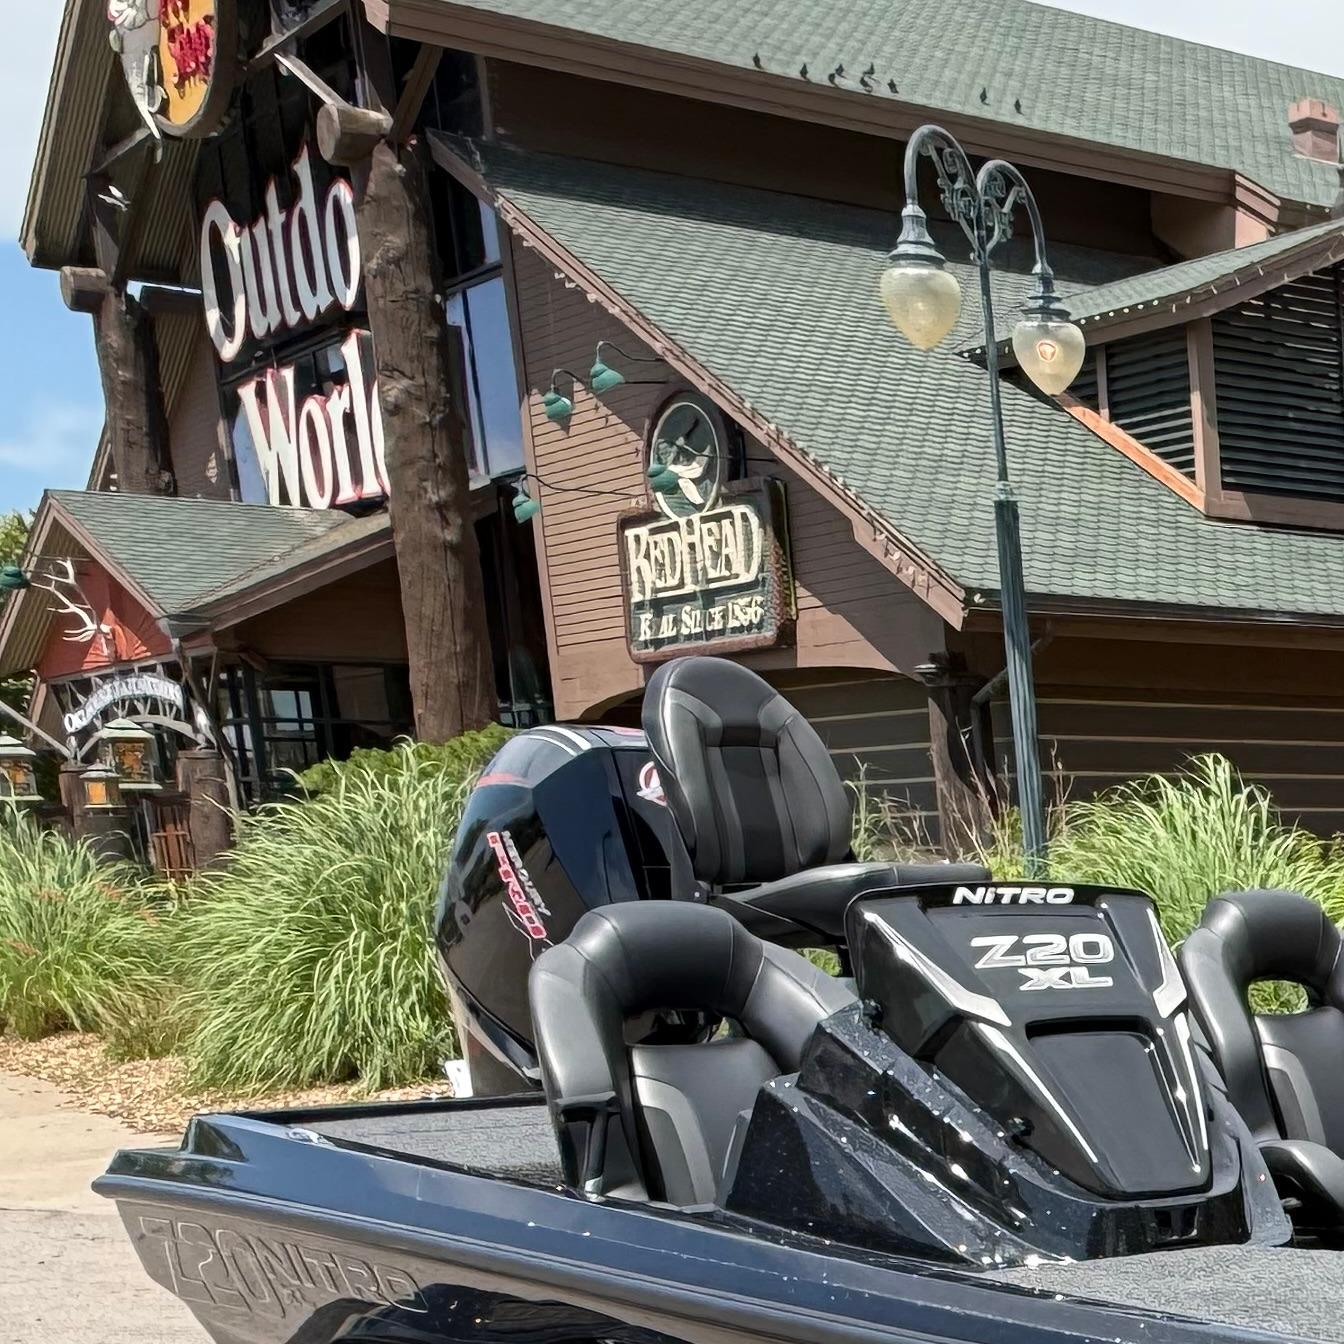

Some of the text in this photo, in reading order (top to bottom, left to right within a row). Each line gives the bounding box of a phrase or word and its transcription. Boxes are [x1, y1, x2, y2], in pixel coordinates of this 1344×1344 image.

[201, 144, 361, 363] Outdo
[970, 933, 1115, 970] Z20
[1017, 965, 1114, 992] XL
